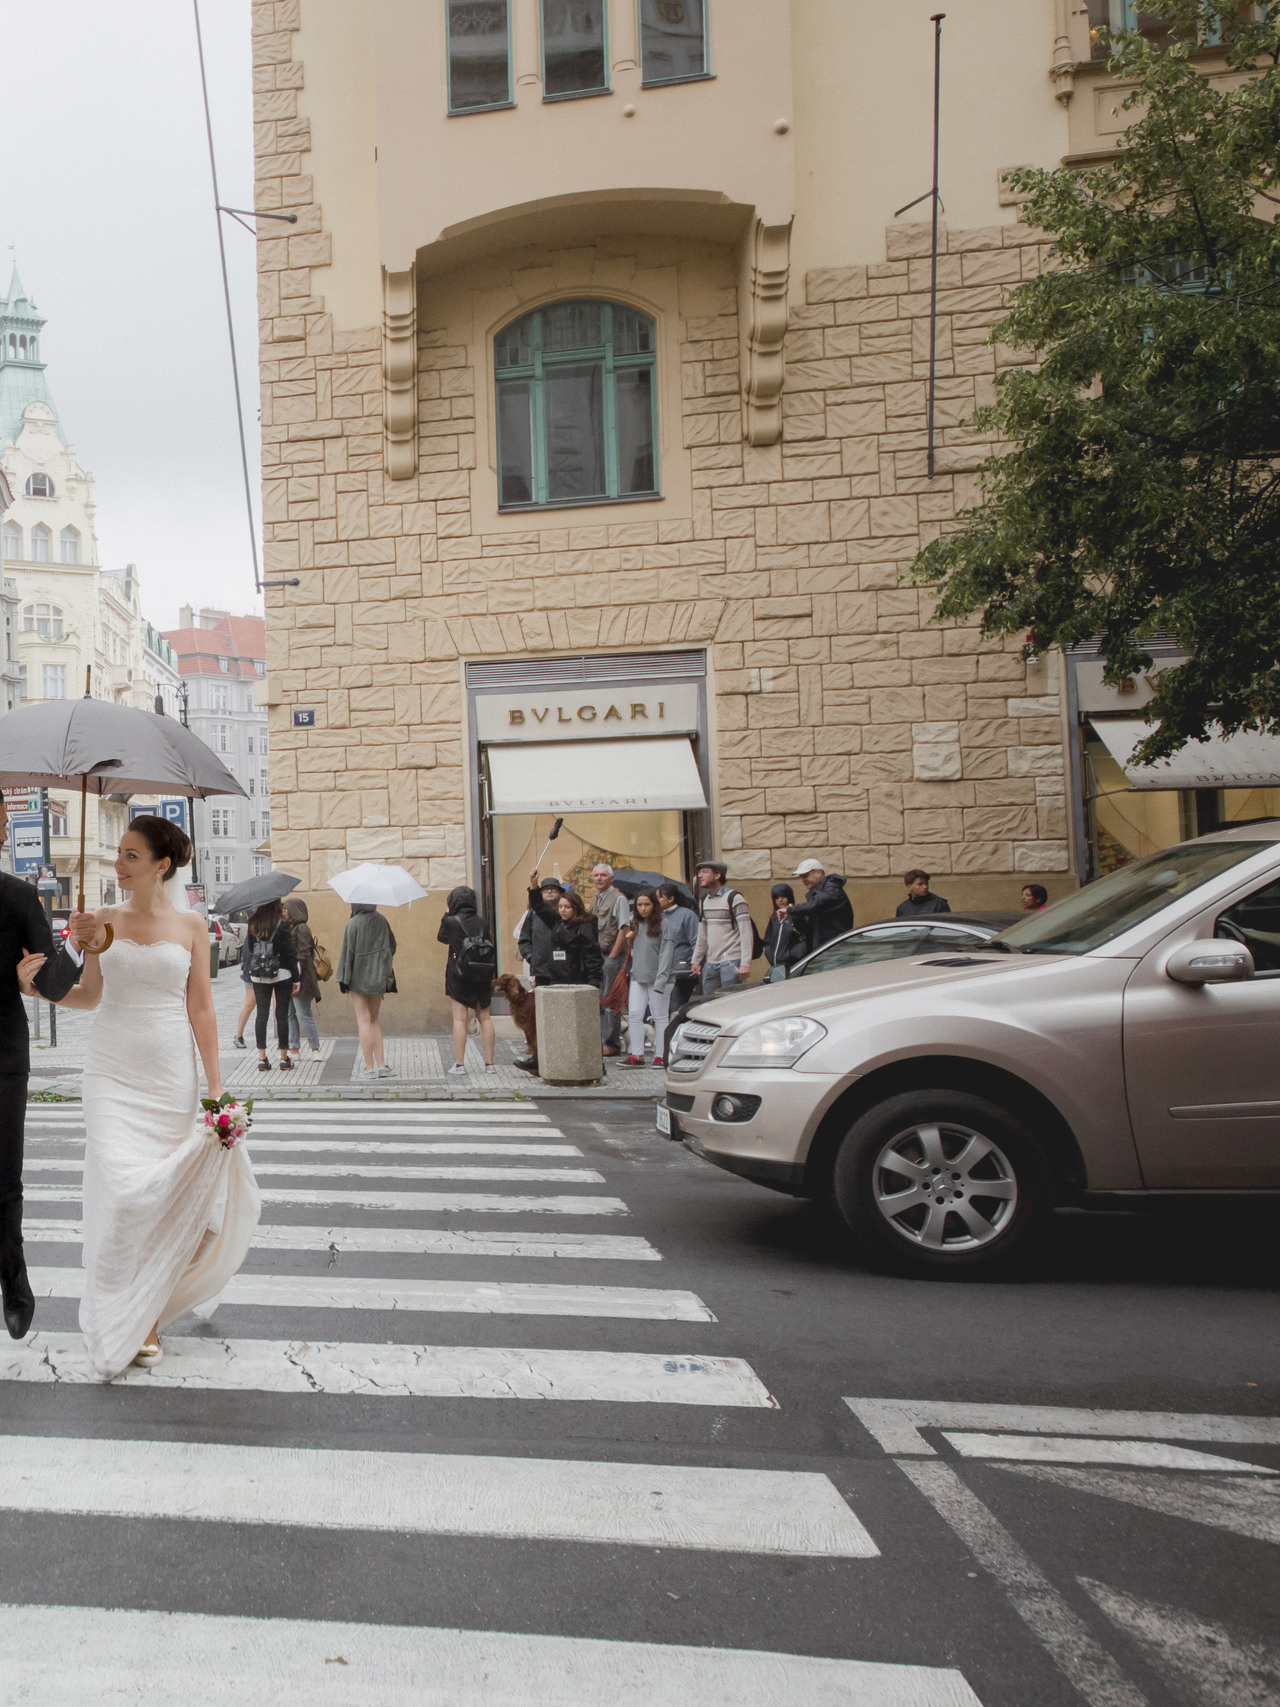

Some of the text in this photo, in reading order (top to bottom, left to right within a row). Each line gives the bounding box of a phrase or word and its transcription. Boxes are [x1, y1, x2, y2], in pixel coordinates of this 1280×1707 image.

[298, 712, 309, 723] 15
[508, 701, 665, 725] BVLGARI
[7, 802, 28, 811] informace
[549, 798, 648, 807] BVLGARI
